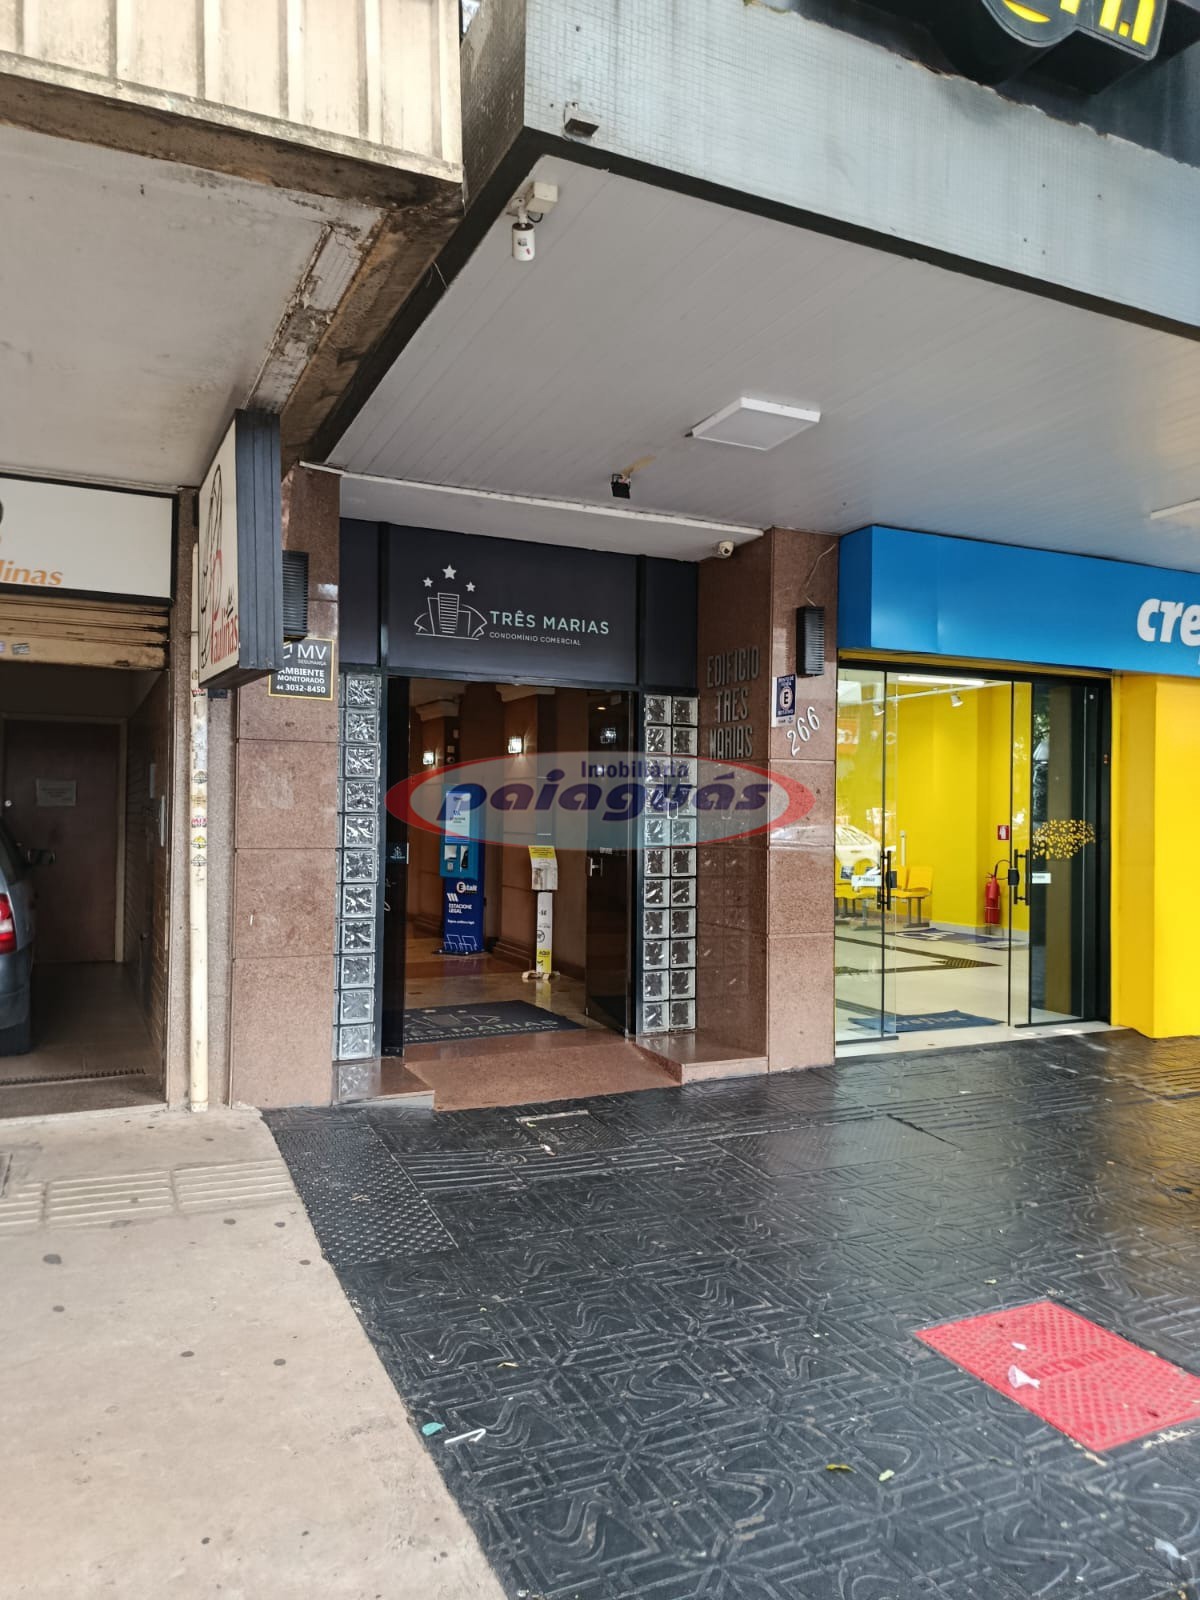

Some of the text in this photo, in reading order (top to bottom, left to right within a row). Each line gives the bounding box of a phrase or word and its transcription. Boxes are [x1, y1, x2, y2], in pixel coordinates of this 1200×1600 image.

[489, 609, 610, 635] TRÊS MARIAS
[1137, 598, 1200, 647] cre
[297, 643, 328, 660] MV
[489, 631, 582, 647] CONDOMÍNIO COMERCIAL
[277, 674, 326, 684] MONITORADO
[706, 646, 759, 688] EDIFICIO
[285, 683, 327, 694] 3032-8450
[709, 725, 753, 760] MARIAS
[786, 706, 821, 758] 266
